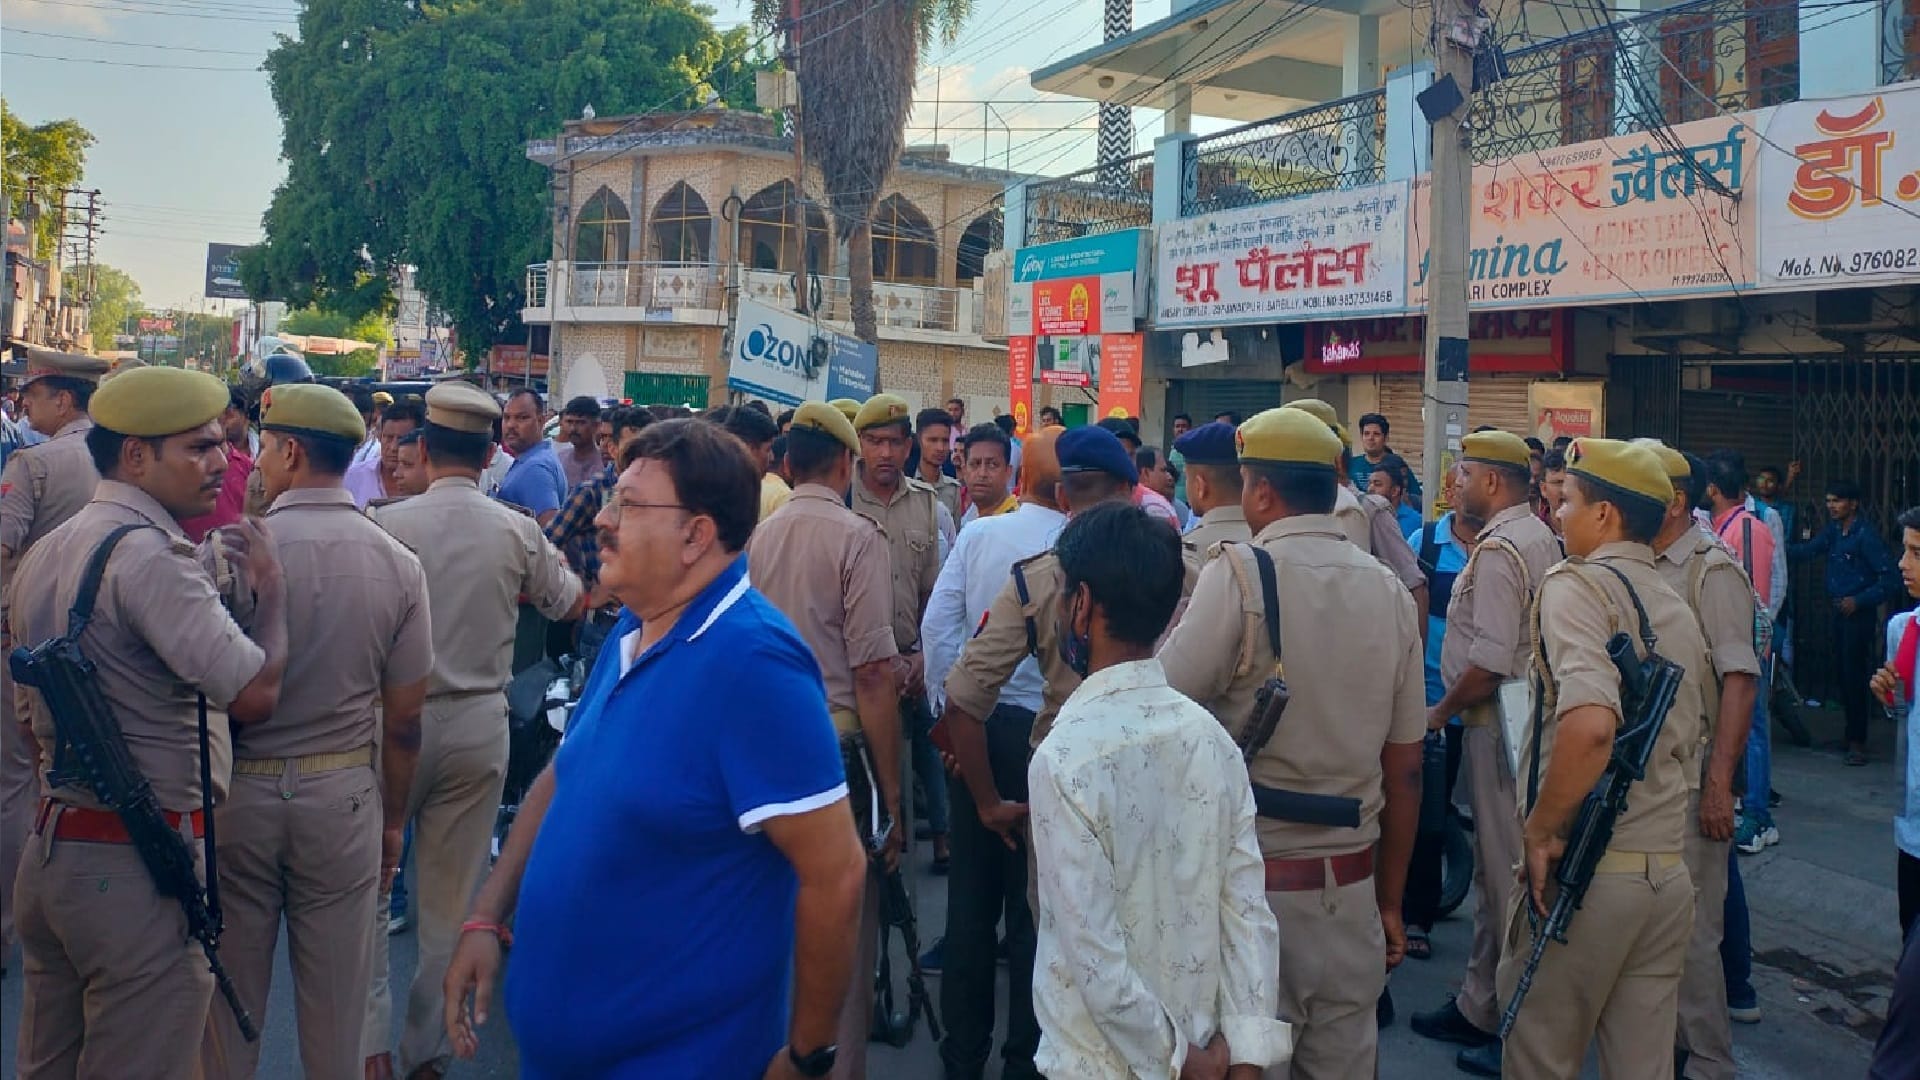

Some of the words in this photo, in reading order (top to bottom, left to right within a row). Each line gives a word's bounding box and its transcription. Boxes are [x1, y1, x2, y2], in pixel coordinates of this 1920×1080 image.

[1849, 247, 1920, 273] 976082
[1491, 279, 1552, 299] COMPLEX
[740, 323, 816, 376] OZON
